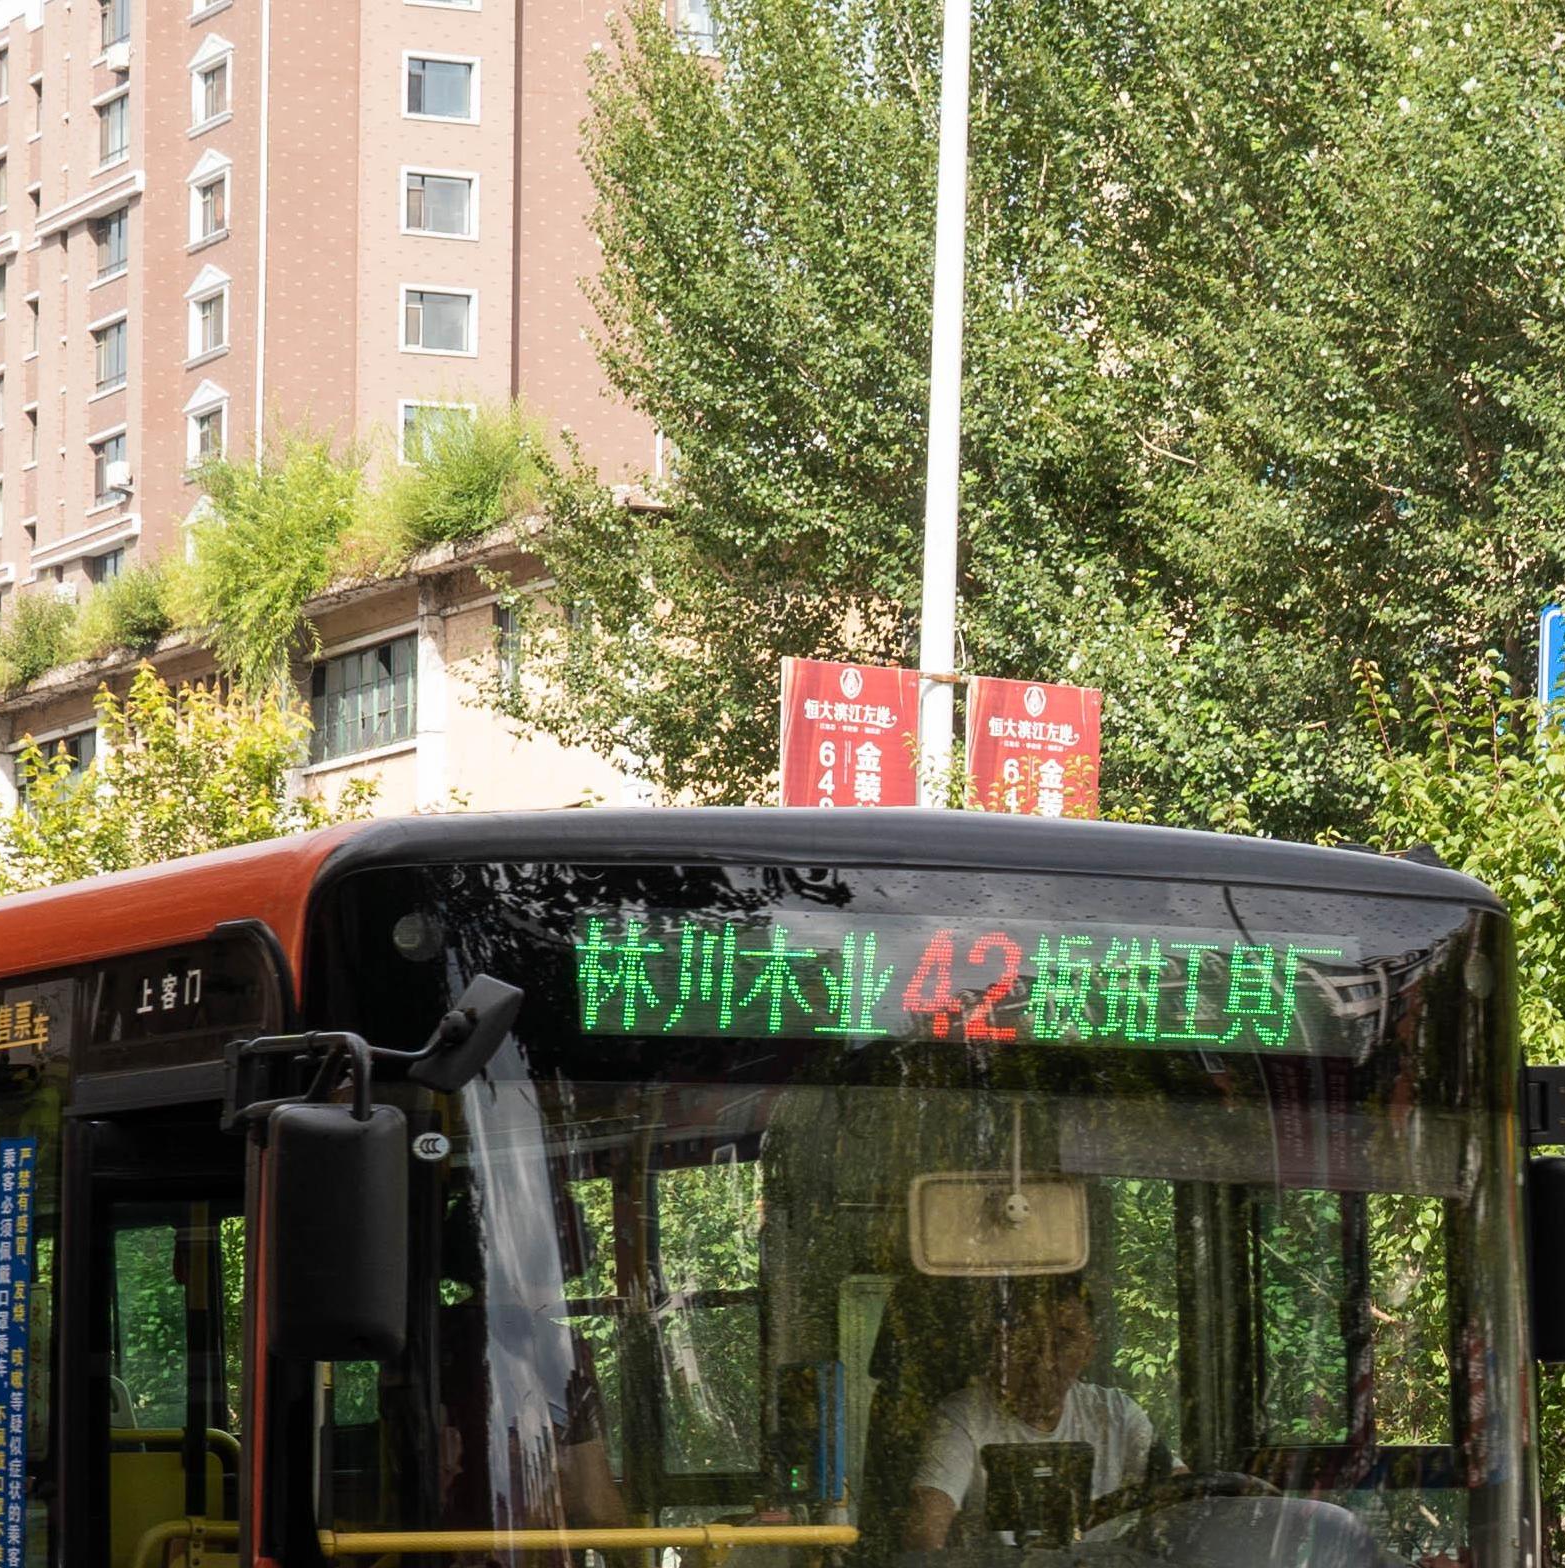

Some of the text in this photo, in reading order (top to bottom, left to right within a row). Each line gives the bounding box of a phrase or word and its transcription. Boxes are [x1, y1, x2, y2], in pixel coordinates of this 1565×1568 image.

[854, 741, 882, 807] 金装
[136, 968, 203, 1014] 上客门
[575, 917, 1342, 1046] 林川木业 42 板钳工具厂
